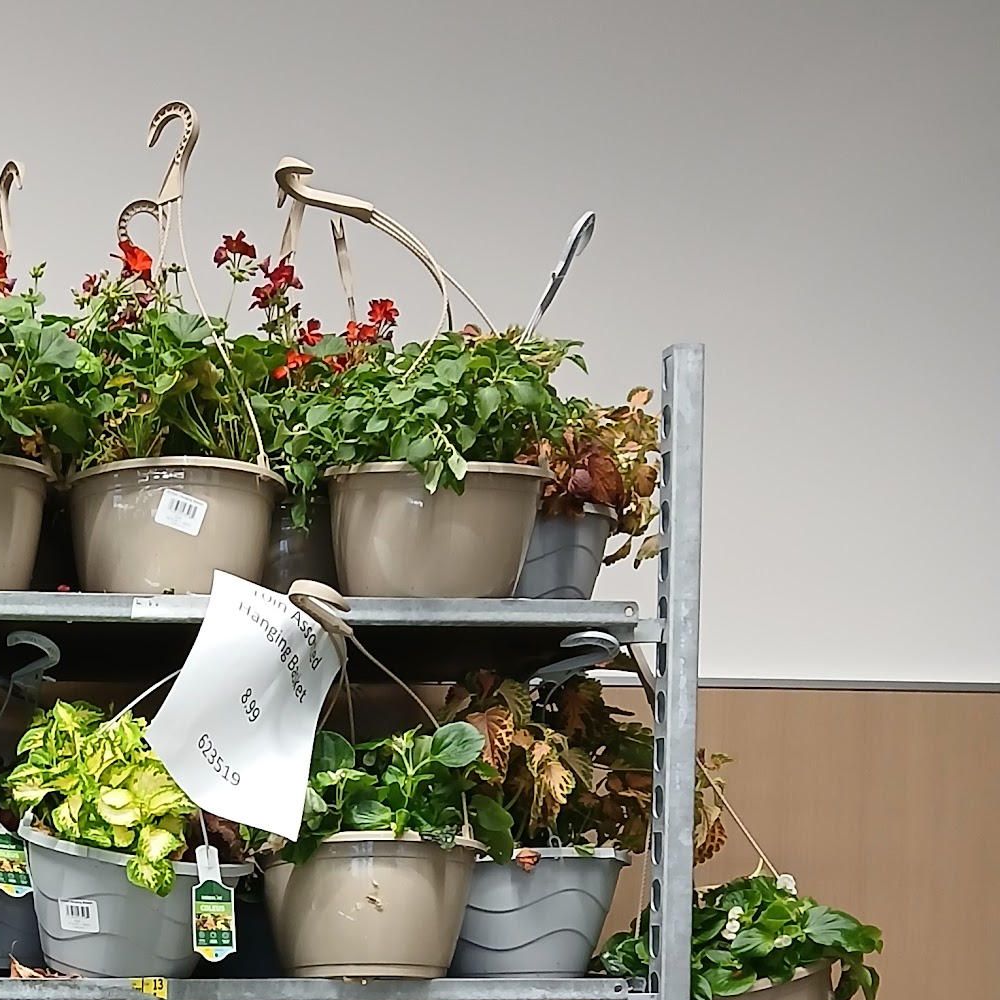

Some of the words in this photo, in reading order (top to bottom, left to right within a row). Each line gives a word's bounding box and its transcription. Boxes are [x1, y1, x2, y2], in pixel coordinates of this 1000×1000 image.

[238, 601, 291, 663] Hanging
[241, 688, 260, 722] 8.99
[198, 734, 241, 786] 623519
[153, 978, 164, 991] 13
